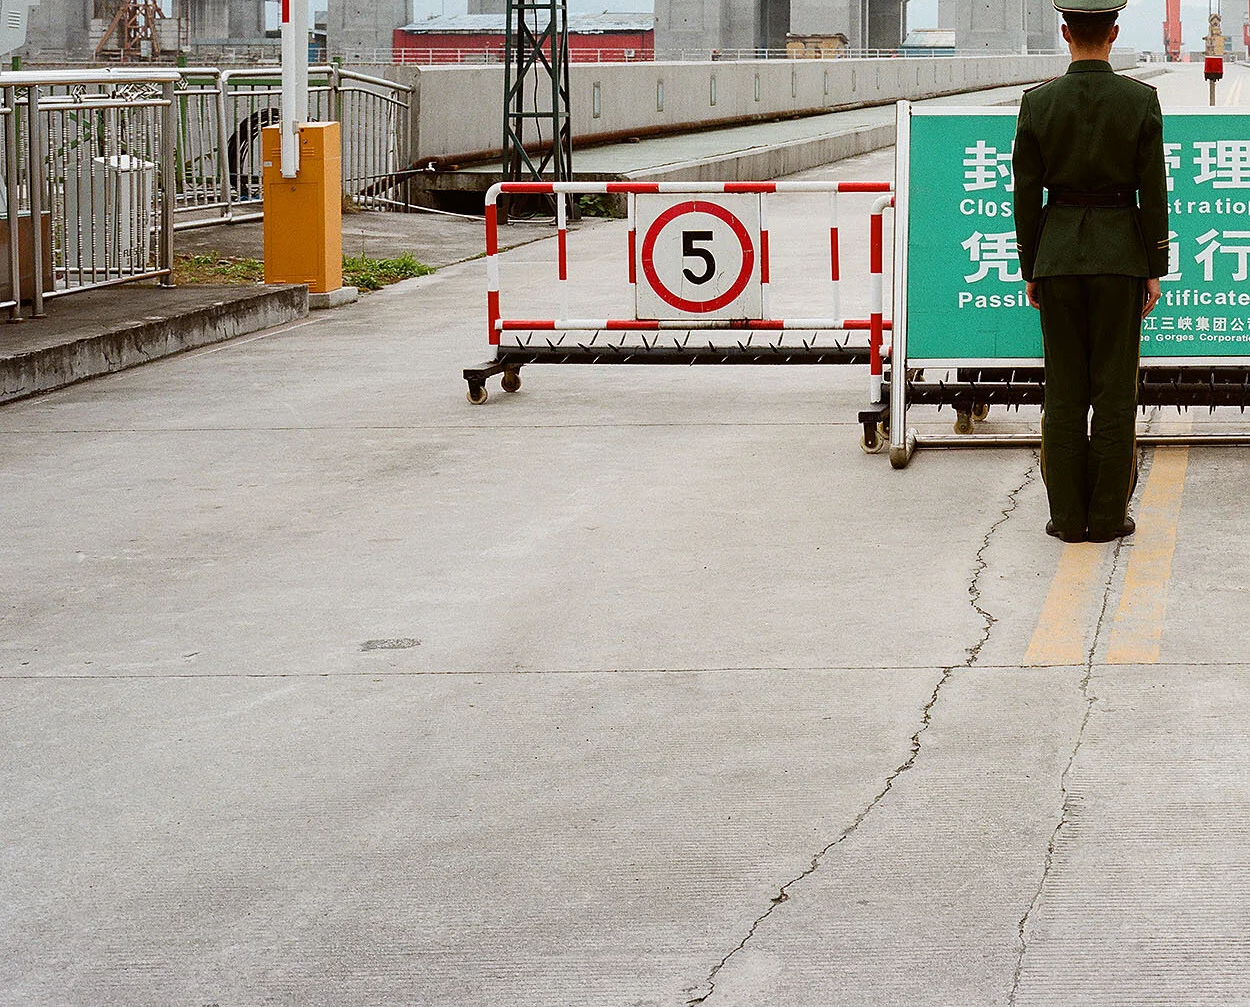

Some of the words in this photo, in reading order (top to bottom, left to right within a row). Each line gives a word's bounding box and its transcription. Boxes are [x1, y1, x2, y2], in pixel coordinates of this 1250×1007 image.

[960, 199, 1013, 217] Clos
[682, 230, 716, 285] 5
[1155, 333, 1195, 343] Gorges
